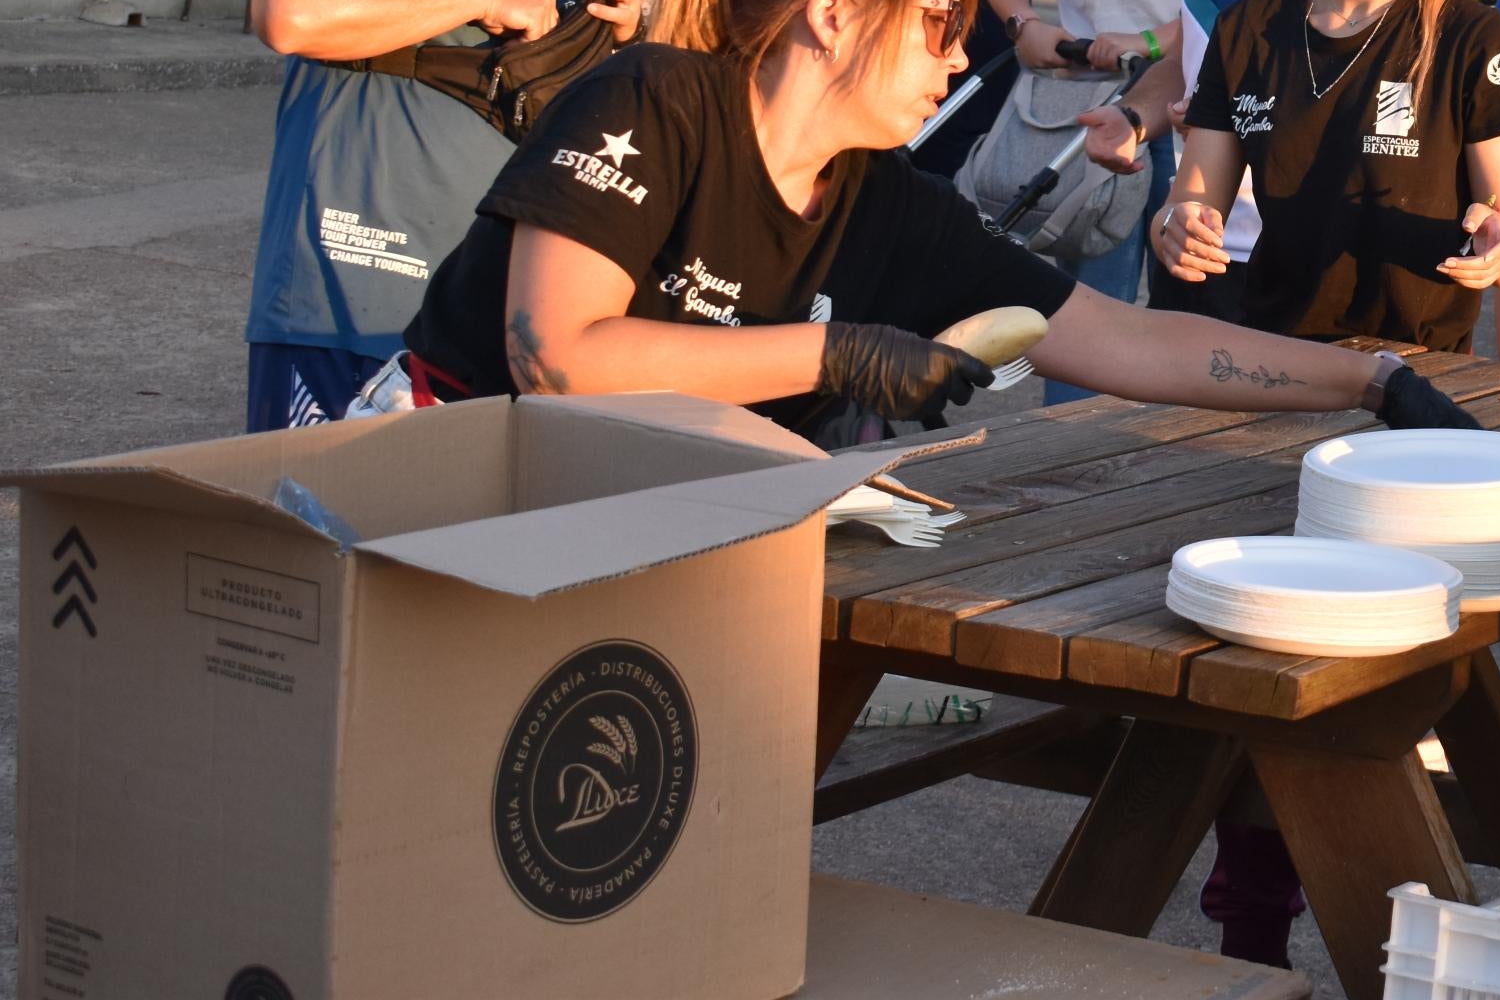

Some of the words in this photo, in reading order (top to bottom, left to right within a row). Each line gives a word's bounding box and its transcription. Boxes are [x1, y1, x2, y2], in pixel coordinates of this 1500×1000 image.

[1233, 93, 1276, 116] Miguel
[1362, 142, 1420, 158] BENITEZ
[1363, 135, 1420, 147] ESPECTACULOS
[551, 148, 649, 205] ESTRELLA
[574, 170, 609, 192] DAMM
[323, 207, 359, 224] NEVER
[320, 228, 347, 243] YOUR
[347, 235, 387, 251] POWER
[321, 217, 408, 245] UNDERESTIMATE
[329, 249, 373, 267] CHANGE
[659, 273, 688, 296] El
[221, 579, 282, 601] PRODUCTO
[201, 586, 303, 620] ULTRACONGELADO
[601, 662, 684, 758] DISTRIBUCIONES
[659, 766, 684, 830] DLUXE
